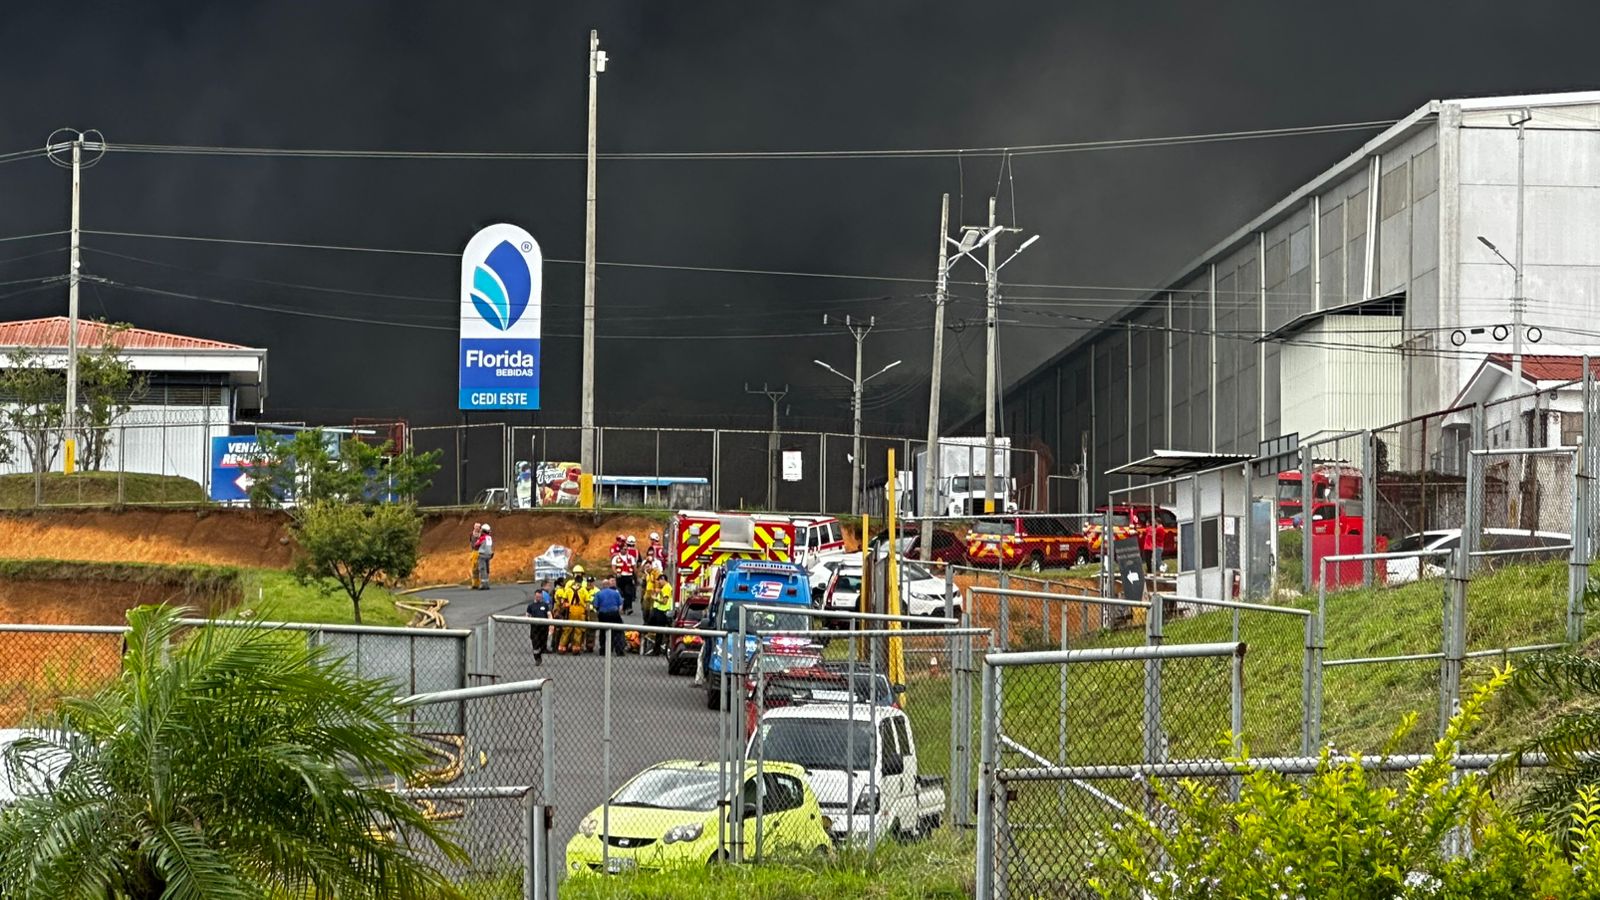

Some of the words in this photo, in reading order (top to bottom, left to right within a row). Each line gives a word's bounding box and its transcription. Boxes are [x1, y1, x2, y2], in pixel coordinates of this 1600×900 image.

[466, 350, 534, 367] Florida
[496, 369, 533, 377] BEBIDAS
[471, 392, 497, 405] CEDI
[499, 392, 527, 405] ESTE
